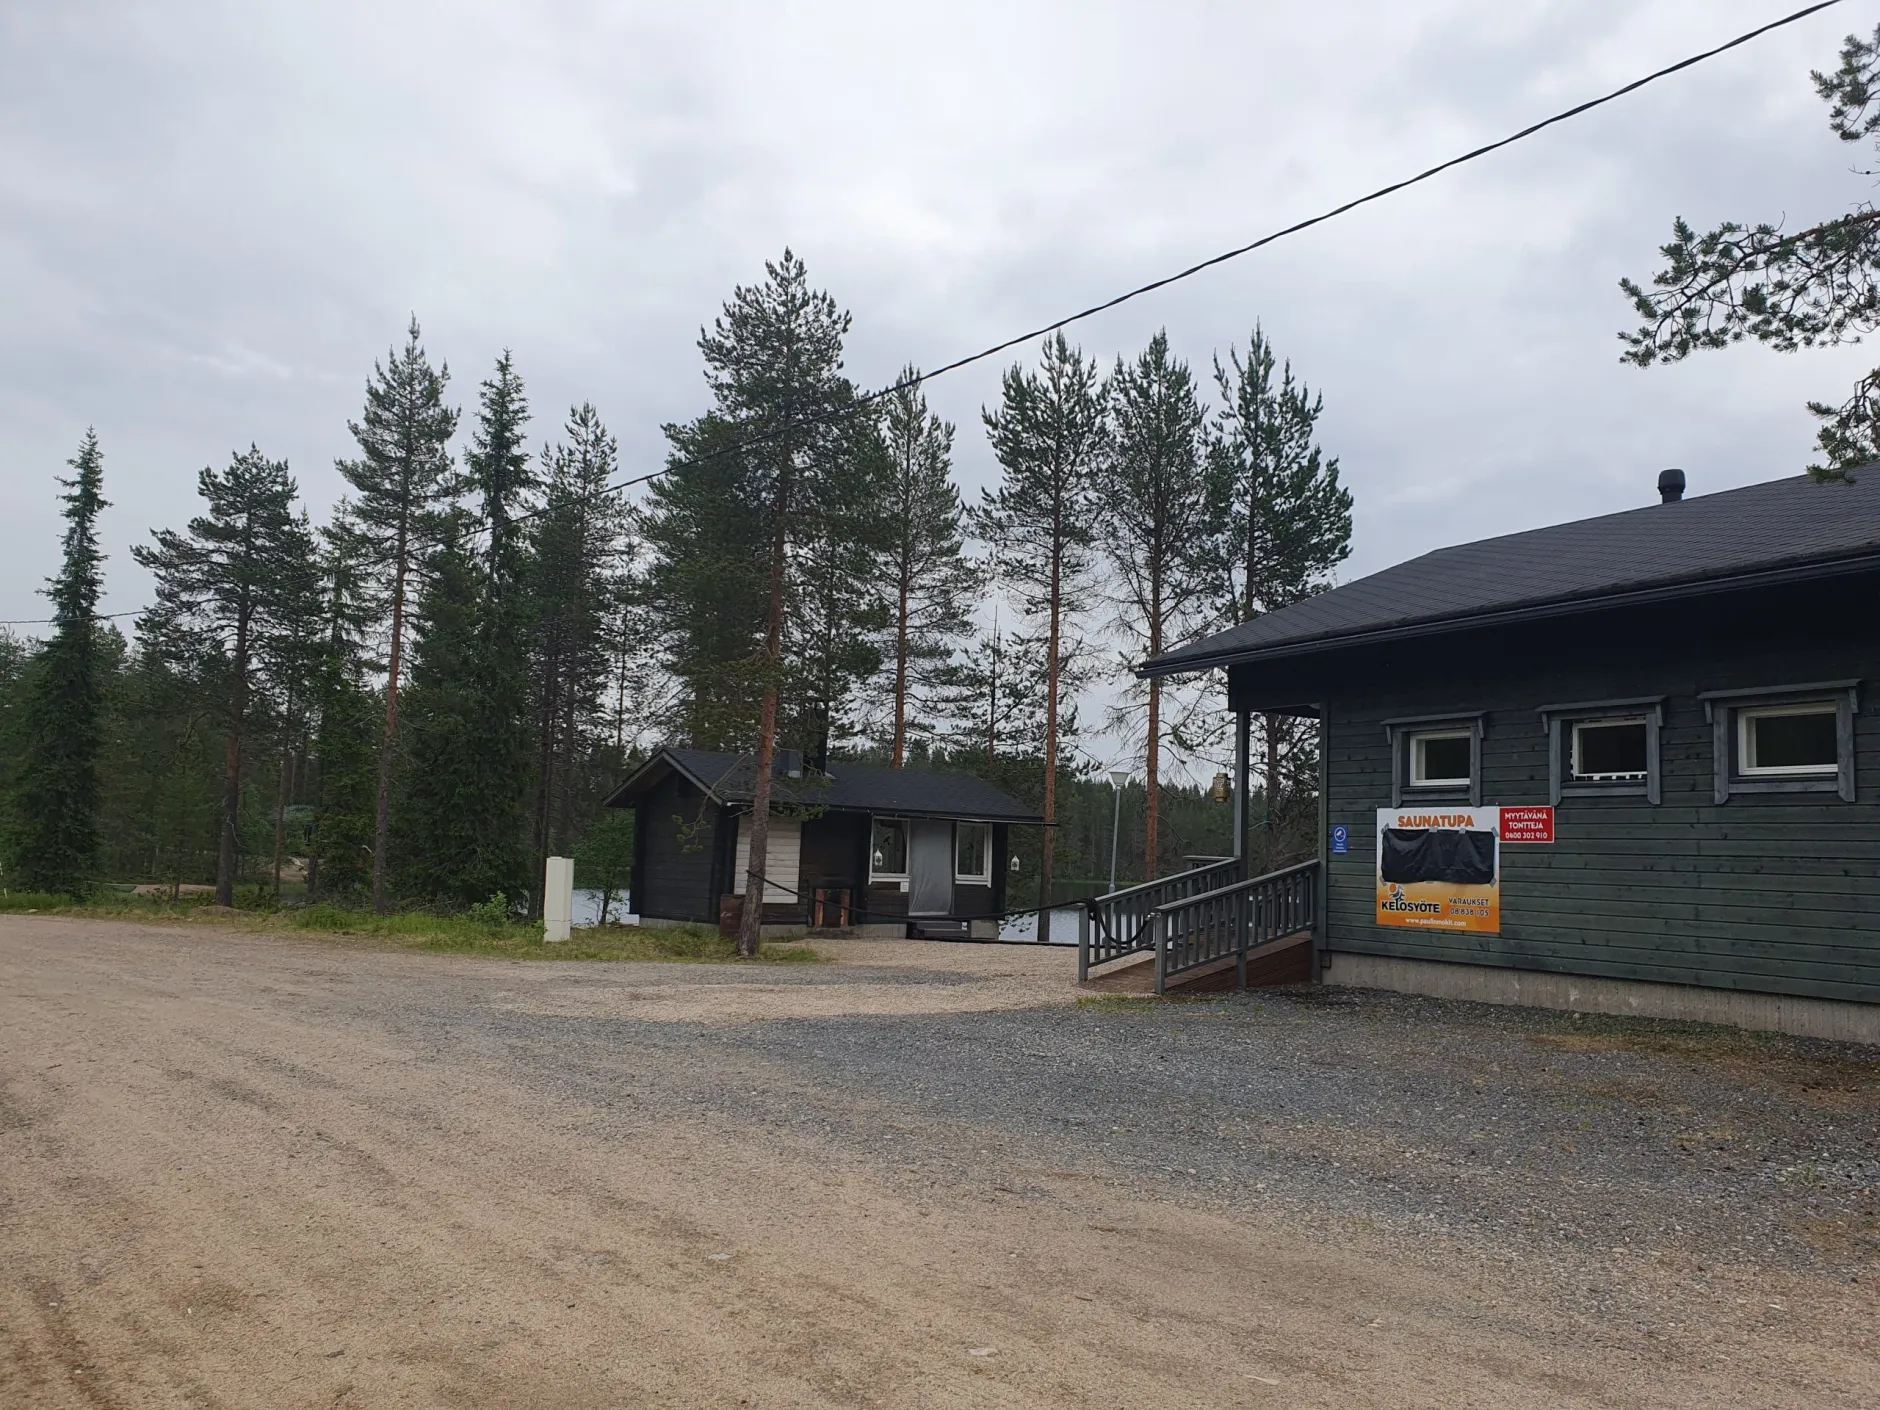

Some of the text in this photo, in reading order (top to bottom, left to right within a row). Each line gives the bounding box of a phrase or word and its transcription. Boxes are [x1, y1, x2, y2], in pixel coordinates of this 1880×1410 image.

[1505, 809, 1547, 819] MYYTÄVÄNÄ
[1397, 815, 1474, 828] SAUNATUPA
[1508, 821, 1543, 829] TONTTEJA
[1448, 897, 1489, 906] VARAUKSET
[1381, 900, 1440, 913] KELOSYÖTE
[1450, 907, 1459, 915] 08
[1461, 908, 1474, 916] 838
[1405, 918, 1467, 927] www.paulinmokit.com
